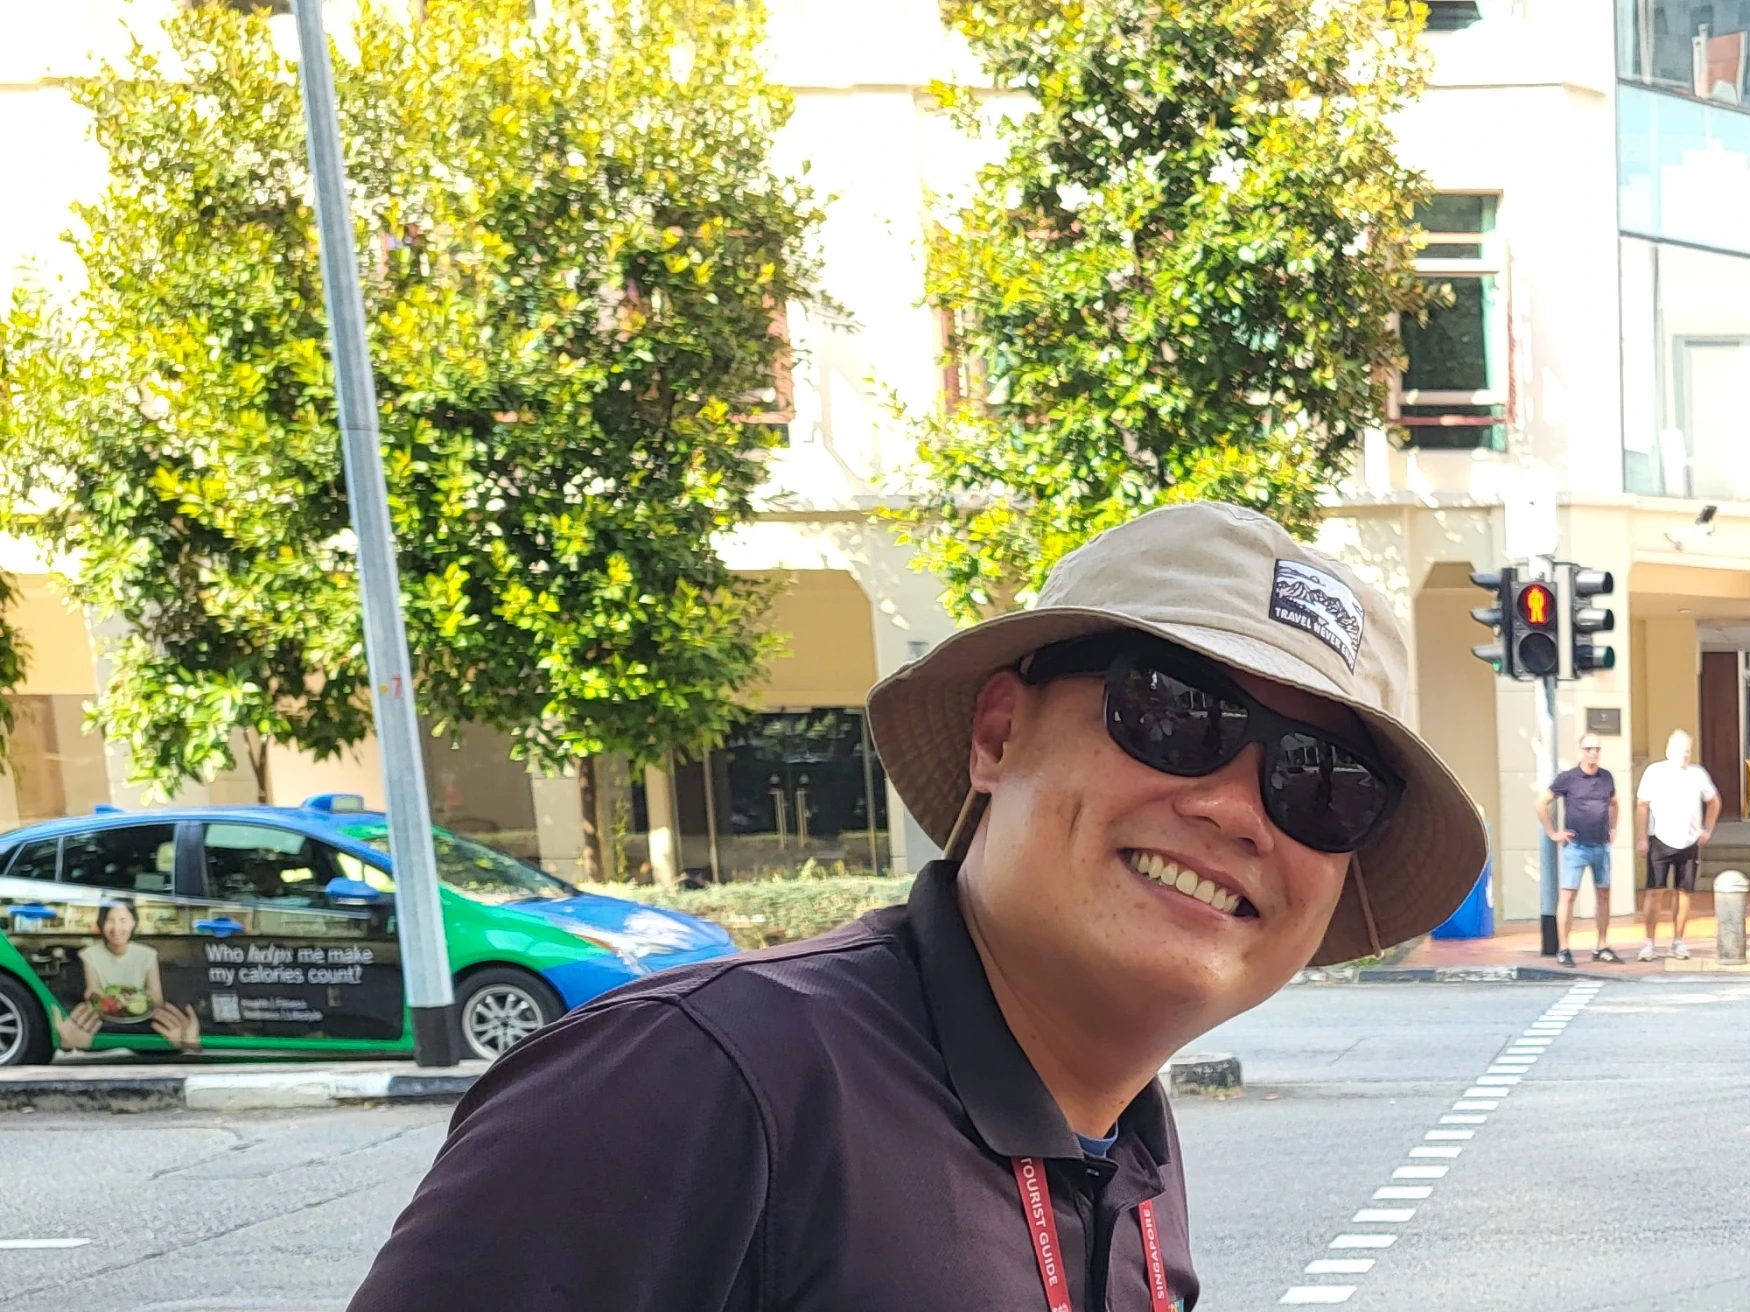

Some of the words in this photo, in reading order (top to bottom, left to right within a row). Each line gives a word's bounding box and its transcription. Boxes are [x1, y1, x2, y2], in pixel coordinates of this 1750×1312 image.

[1274, 606, 1313, 630] TRAVEL
[1313, 622, 1342, 649] NEVER
[206, 943, 244, 963] Who
[247, 943, 293, 966] helps
[297, 947, 325, 964] me
[327, 945, 373, 964] make
[208, 967, 235, 986] my
[238, 965, 305, 984] calories
[308, 964, 363, 984] count?
[1020, 1157, 1046, 1228] TOURIST
[1039, 1232, 1059, 1287] GUIDE
[1143, 1208, 1165, 1300] SINGAPORE
